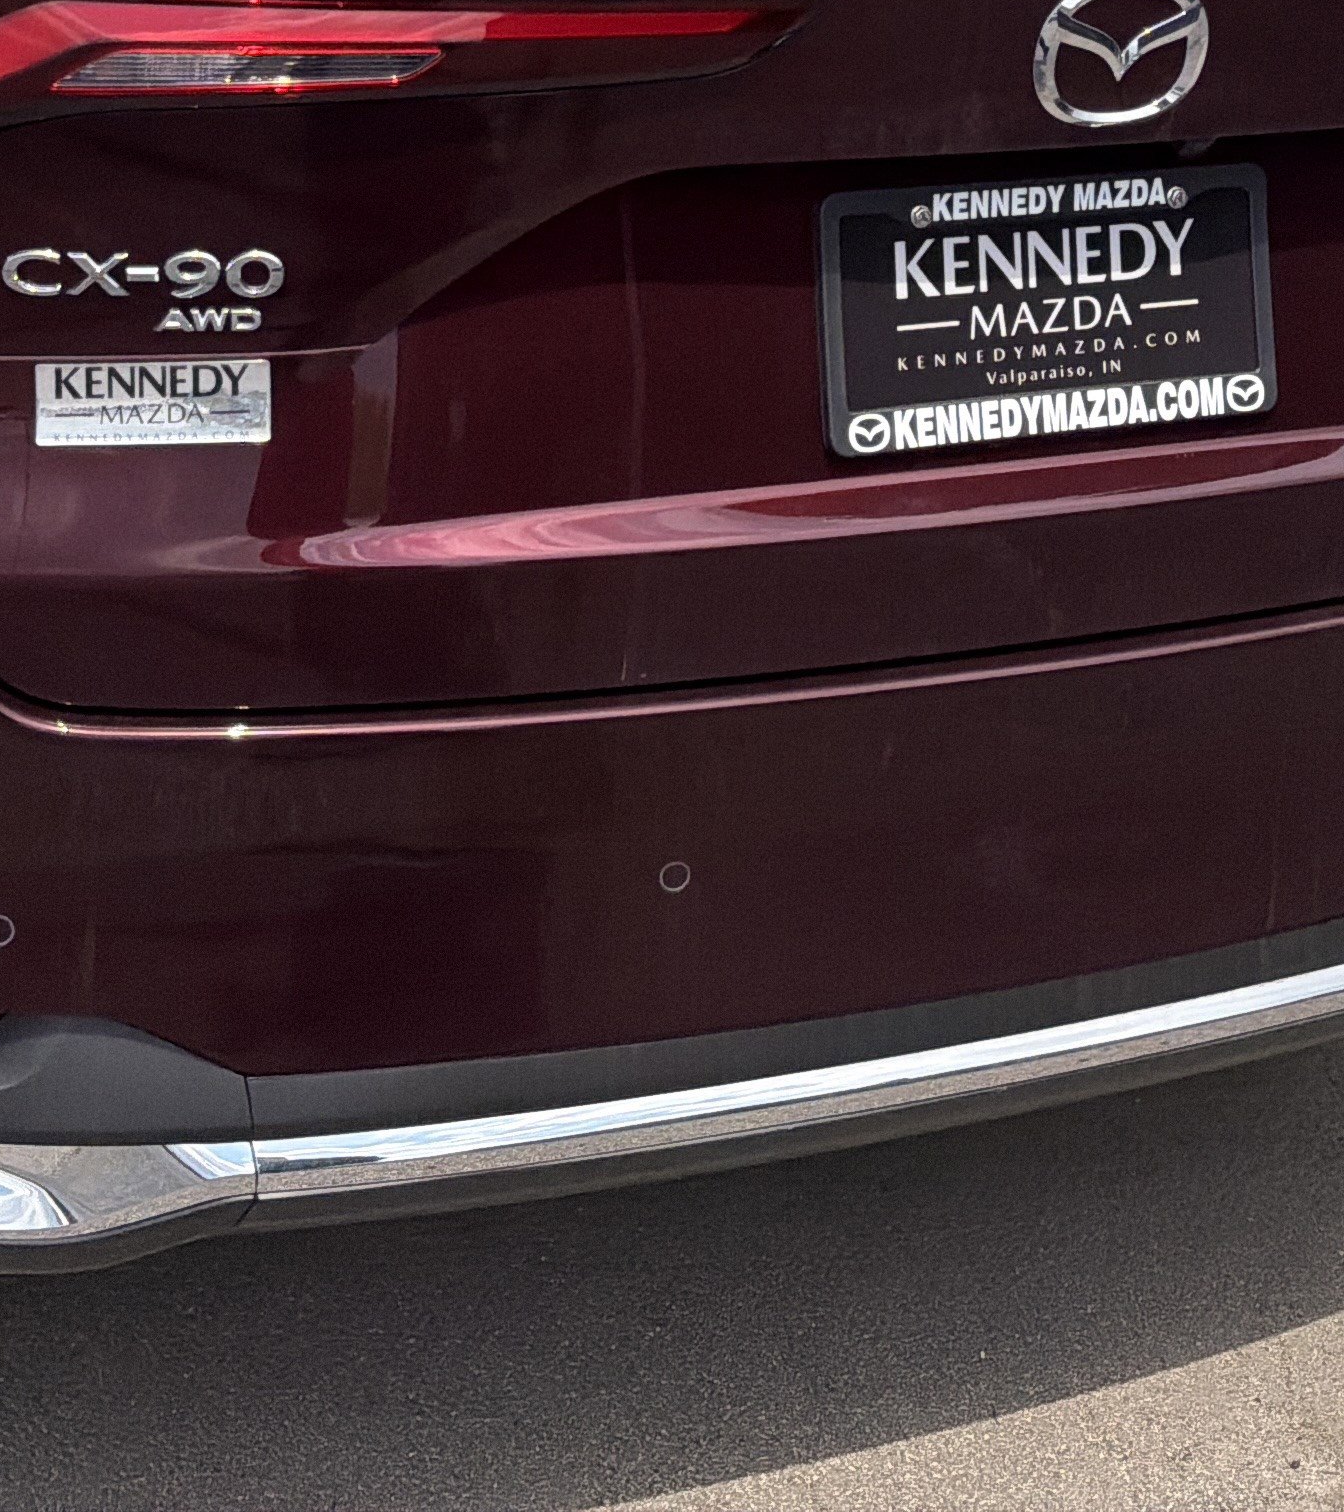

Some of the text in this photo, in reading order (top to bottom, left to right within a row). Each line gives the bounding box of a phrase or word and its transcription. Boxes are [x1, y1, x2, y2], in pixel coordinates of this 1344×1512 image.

[932, 177, 1167, 222] KENNEDY MAZDA
[2, 248, 285, 298] CX-90
[894, 218, 1195, 300] KENNEDY
[154, 307, 262, 332] AWD
[970, 292, 1133, 341] MAZDA
[897, 329, 1201, 372] KENNEDYMAZDA.COM
[986, 358, 1122, 386] Valparaiso, IN
[54, 363, 249, 400] KENNEDY
[99, 402, 205, 426] MAZDA
[893, 376, 1226, 451] KENNEDYMAZDA.COM
